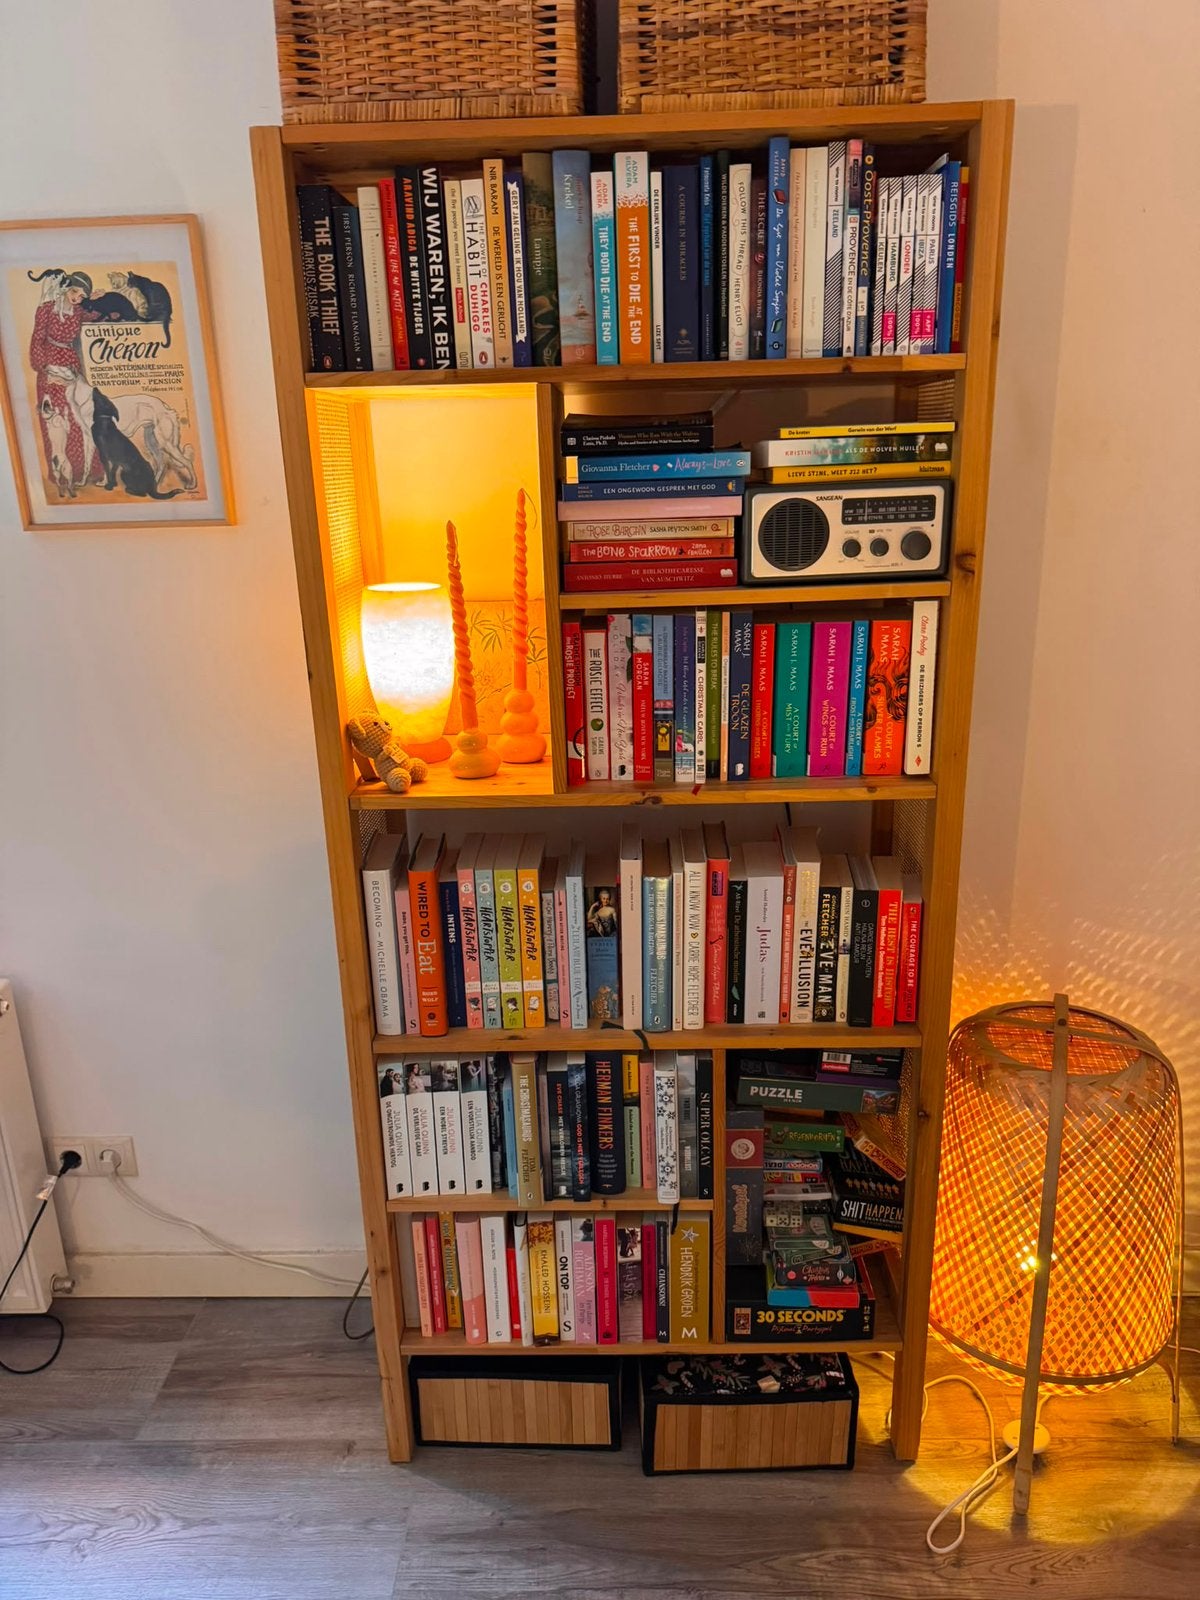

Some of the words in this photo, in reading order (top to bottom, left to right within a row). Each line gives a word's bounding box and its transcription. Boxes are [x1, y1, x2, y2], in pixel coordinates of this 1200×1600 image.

[403, 178, 414, 220] ARAVIND
[422, 168, 439, 207] WIJ
[491, 183, 499, 215] BARAM
[737, 181, 746, 214] FOLLOW
[949, 182, 958, 226] REISGIDS
[314, 217, 331, 246] THE
[407, 223, 416, 252] ADIGA
[492, 226, 498, 236] DE
[599, 226, 609, 247] THEY
[629, 217, 638, 232] THE
[303, 242, 316, 285] MARKUS
[409, 256, 418, 267] DE
[426, 214, 444, 299] WAREN,
[465, 222, 481, 278] HABIT
[493, 239, 502, 270] WERELD
[600, 250, 610, 275] BOTH
[629, 234, 640, 268] FIRST
[736, 239, 746, 270] THREAD
[903, 240, 911, 274] LONDEN
[947, 233, 955, 268] LONDEN
[318, 254, 335, 292] BOOK
[410, 270, 421, 300] WITTE
[495, 272, 502, 280] IS
[601, 277, 610, 294] DIE
[631, 273, 639, 281] TO
[307, 286, 319, 318] ZUSAK
[470, 285, 480, 332] DUHIGG
[480, 282, 491, 334] CHARLES
[630, 284, 640, 303] DIE
[321, 296, 340, 335] THIEF
[413, 302, 424, 334] TIJGER
[432, 306, 448, 327] IK
[498, 298, 506, 339] GERUCHT
[602, 304, 610, 320] THE
[734, 305, 742, 327] ELIOT
[602, 321, 612, 342] END
[630, 321, 641, 344] END
[581, 464, 618, 472] Giovanna
[620, 463, 650, 471] Fletcher
[564, 645, 574, 667] ROSIE
[590, 648, 600, 658] THE
[566, 668, 576, 700] PROJECT
[590, 660, 602, 685] ROSIE
[591, 688, 603, 713] EFFECT
[742, 684, 750, 696] DE
[731, 693, 740, 730] TROON
[740, 698, 749, 740] GLAZEN
[821, 700, 830, 725] WINGS
[876, 695, 885, 727] SILVER
[820, 736, 828, 757] RUIN
[873, 731, 882, 759] FLAMES
[689, 870, 701, 885] ALL
[372, 880, 382, 928] BECOMING
[417, 881, 428, 918] WIRED
[689, 890, 699, 911] KNOW
[888, 902, 898, 924] THE
[420, 922, 430, 937] TO
[447, 914, 456, 944] INTENS
[689, 913, 699, 930] NOW
[821, 893, 830, 937] FLETCHER
[756, 926, 772, 962] Judas
[800, 928, 812, 949] EVE
[887, 927, 896, 953] REST
[908, 934, 916, 967] COURAGE
[377, 941, 386, 978] MICHELLE
[418, 939, 436, 974] Eat
[886, 956, 894, 965] IS
[688, 965, 699, 982] HOPE
[797, 955, 812, 1008] ILLUSION
[908, 969, 914, 977] TO
[380, 979, 389, 1018] OBAMA
[687, 984, 699, 1016] FLETCHER
[884, 968, 894, 1009] HISTORY
[595, 1061, 612, 1103] HERMAN
[750, 1086, 803, 1099] PUZZLE
[446, 1107, 454, 1127] JULIA
[700, 1092, 711, 1130] SUPER
[448, 1128, 456, 1153] QUINN
[598, 1107, 613, 1150] FINKERS
[840, 1200, 867, 1220] SHIT
[865, 1203, 904, 1218] HAPPEN
[540, 1250, 548, 1278] KHALED
[559, 1256, 568, 1271] ON
[574, 1249, 585, 1297] RICHMAN
[680, 1247, 694, 1287] HENDRIK
[560, 1272, 569, 1290] TOP
[542, 1279, 550, 1314] HOSSEINI
[681, 1288, 694, 1318] GROEN
[757, 1310, 774, 1323] 30
[777, 1310, 844, 1323] SECONDS
